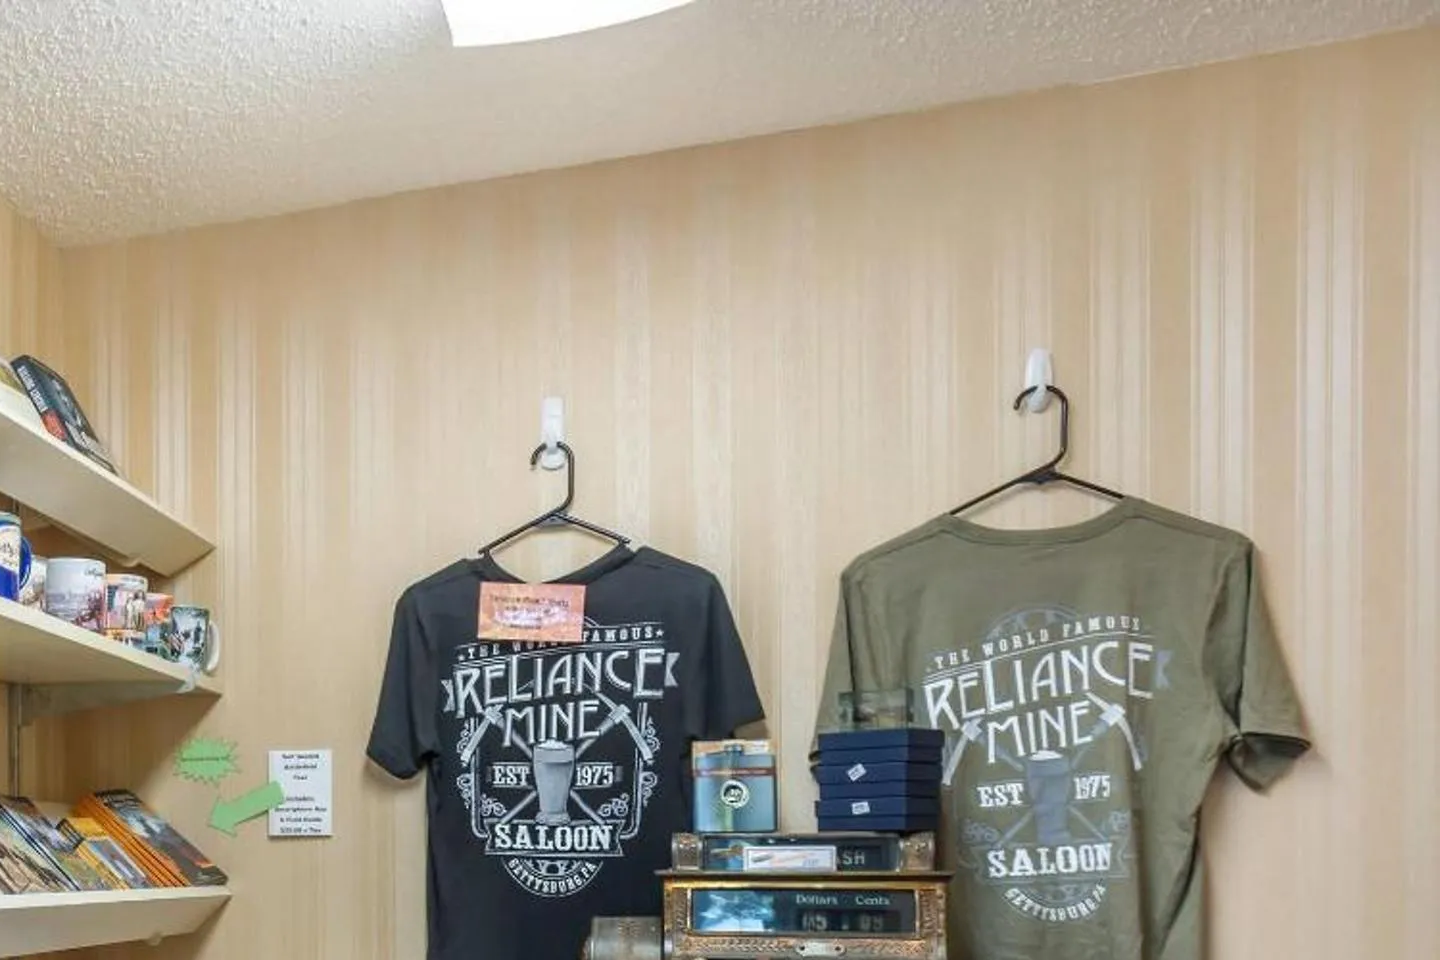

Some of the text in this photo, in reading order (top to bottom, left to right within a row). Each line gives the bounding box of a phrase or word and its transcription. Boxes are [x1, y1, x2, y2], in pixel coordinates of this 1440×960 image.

[582, 626, 653, 643] FAMOUS
[934, 649, 971, 670] THE
[982, 629, 1049, 657] WORLD
[453, 648, 665, 718] RELIANCE
[924, 641, 1153, 730] RELIANCE
[503, 699, 601, 747] MINE
[987, 701, 1093, 764] MINE
[492, 766, 613, 785] EST 1975
[976, 774, 1111, 808] EST 1975
[494, 824, 614, 852] SALOON
[987, 842, 1113, 878] SALOON
[796, 893, 891, 906] Dollars Cents
